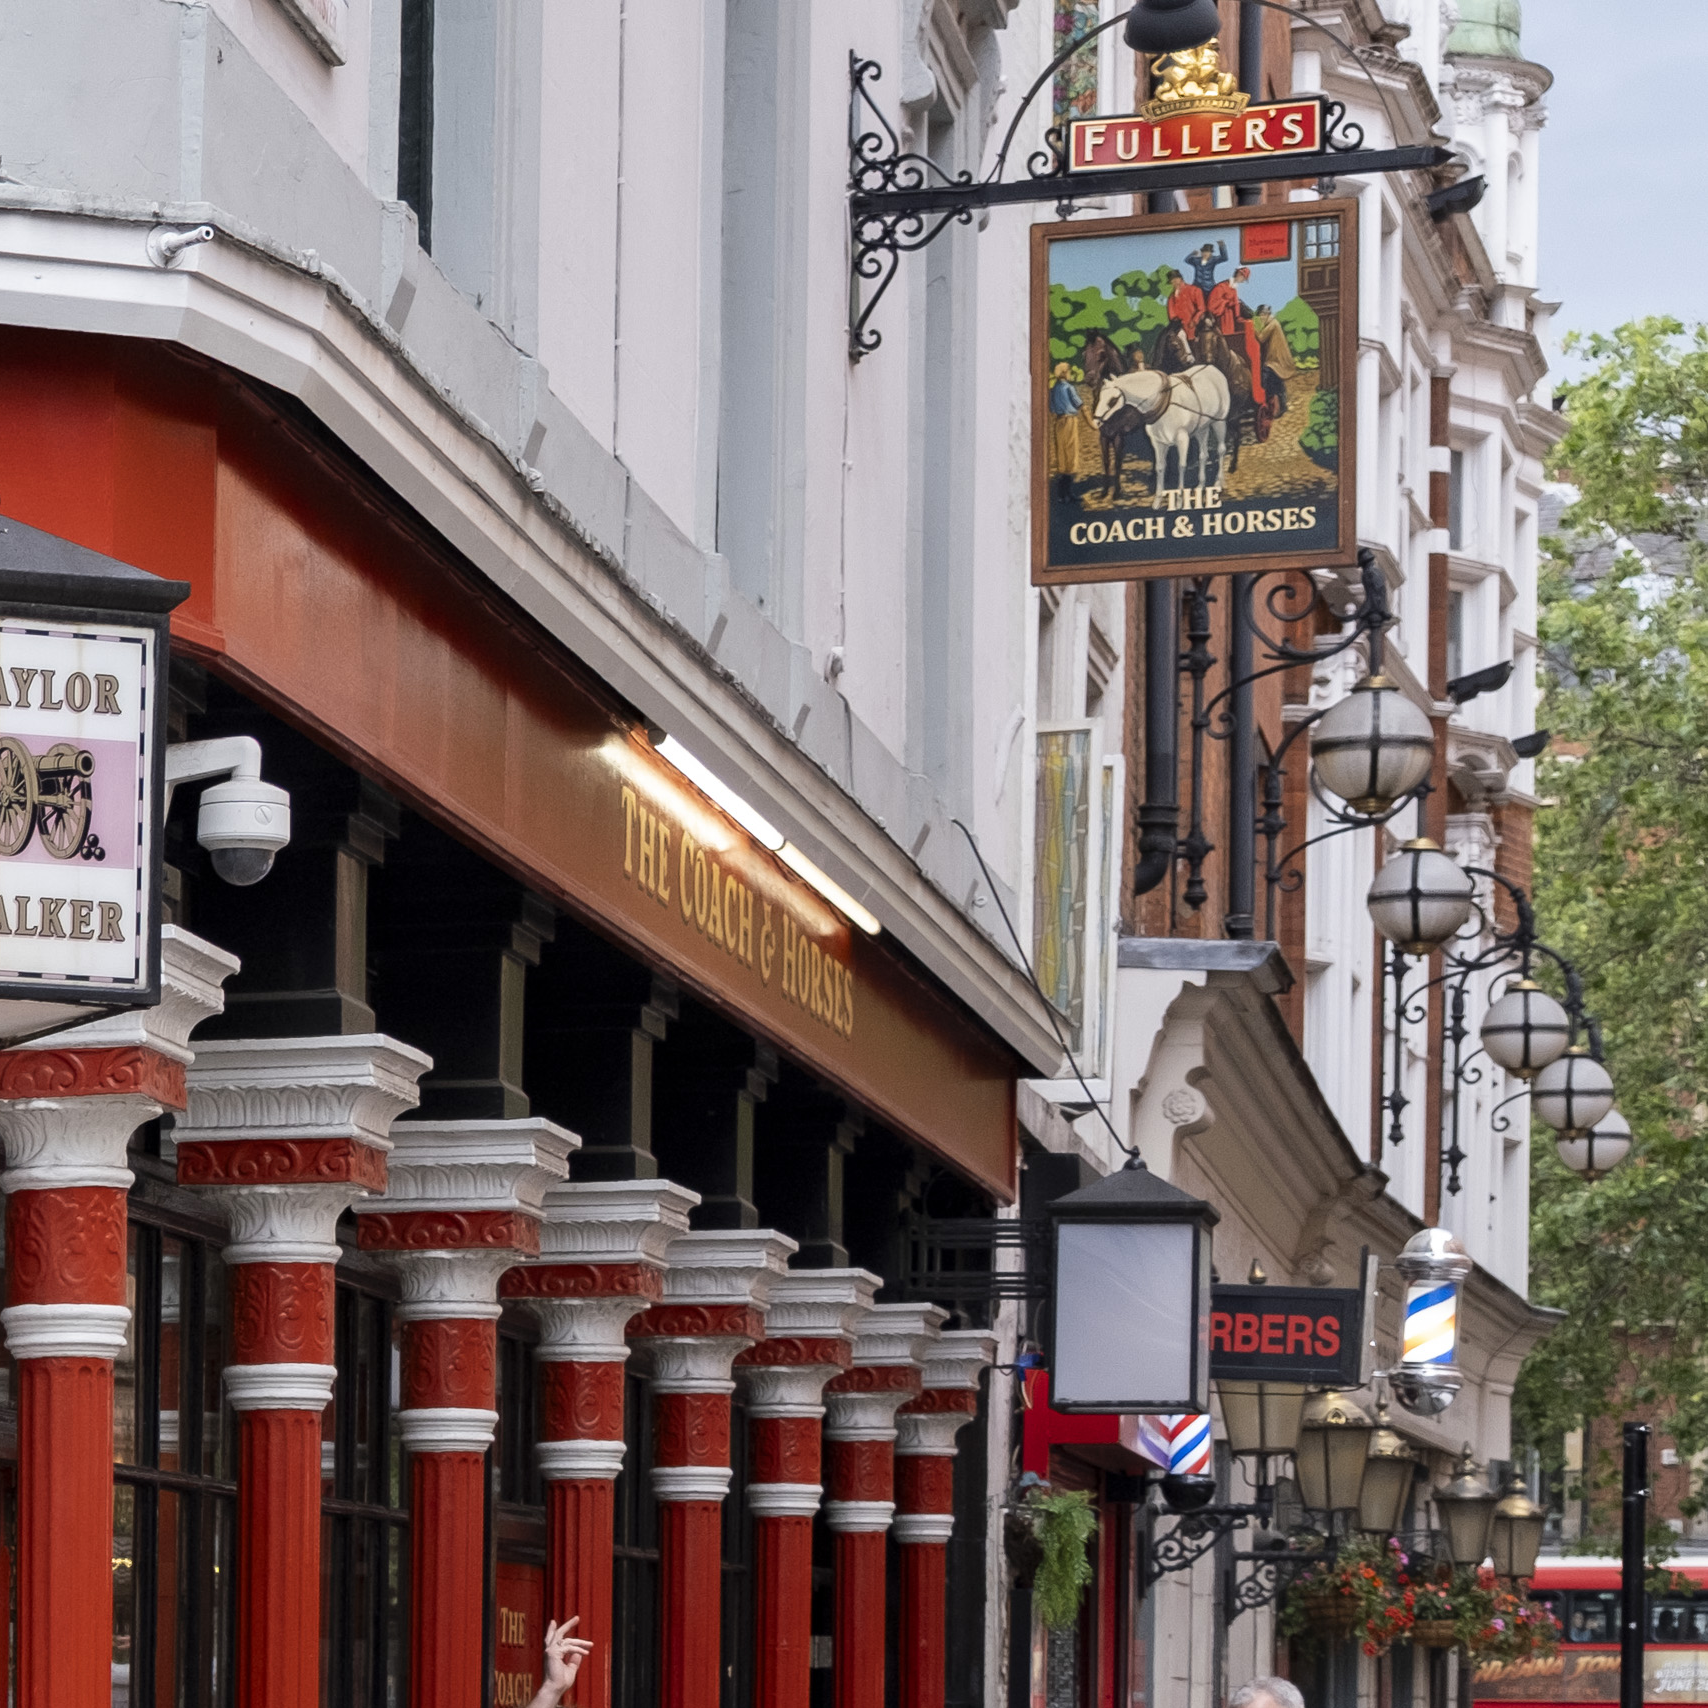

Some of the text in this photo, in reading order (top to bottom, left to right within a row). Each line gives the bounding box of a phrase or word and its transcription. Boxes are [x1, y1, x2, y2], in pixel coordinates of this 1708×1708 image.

[1085, 109, 1304, 162] FULLER'S
[1162, 486, 1223, 512] THE
[1070, 506, 1317, 545] COACH & HORSES
[621, 786, 854, 1036] THE COACH & HORSES
[1210, 1312, 1341, 1357] RBERS
[500, 1607, 526, 1645] THE
